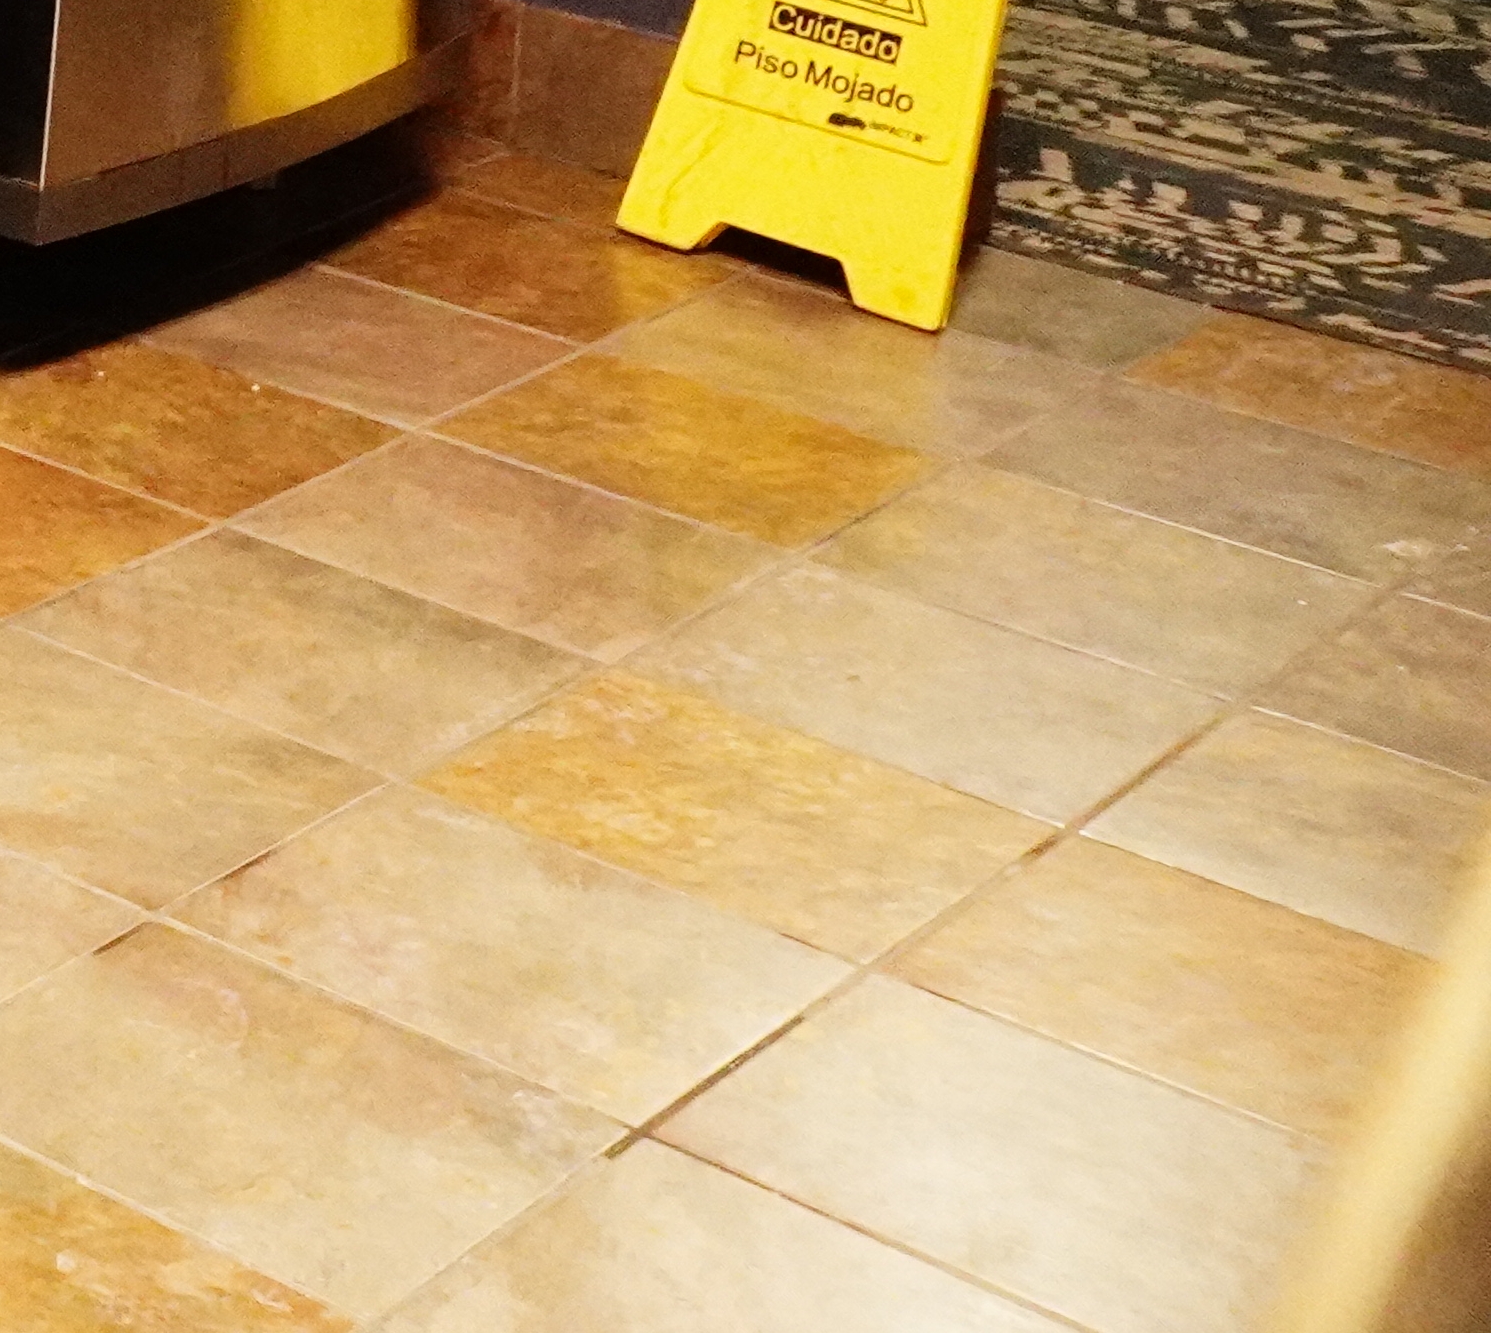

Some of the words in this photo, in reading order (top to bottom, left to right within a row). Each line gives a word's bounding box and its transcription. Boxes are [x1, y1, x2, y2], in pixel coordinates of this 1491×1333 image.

[771, 3, 901, 66] Cuidado
[733, 40, 800, 82] Piso
[802, 59, 915, 116] Mojado
